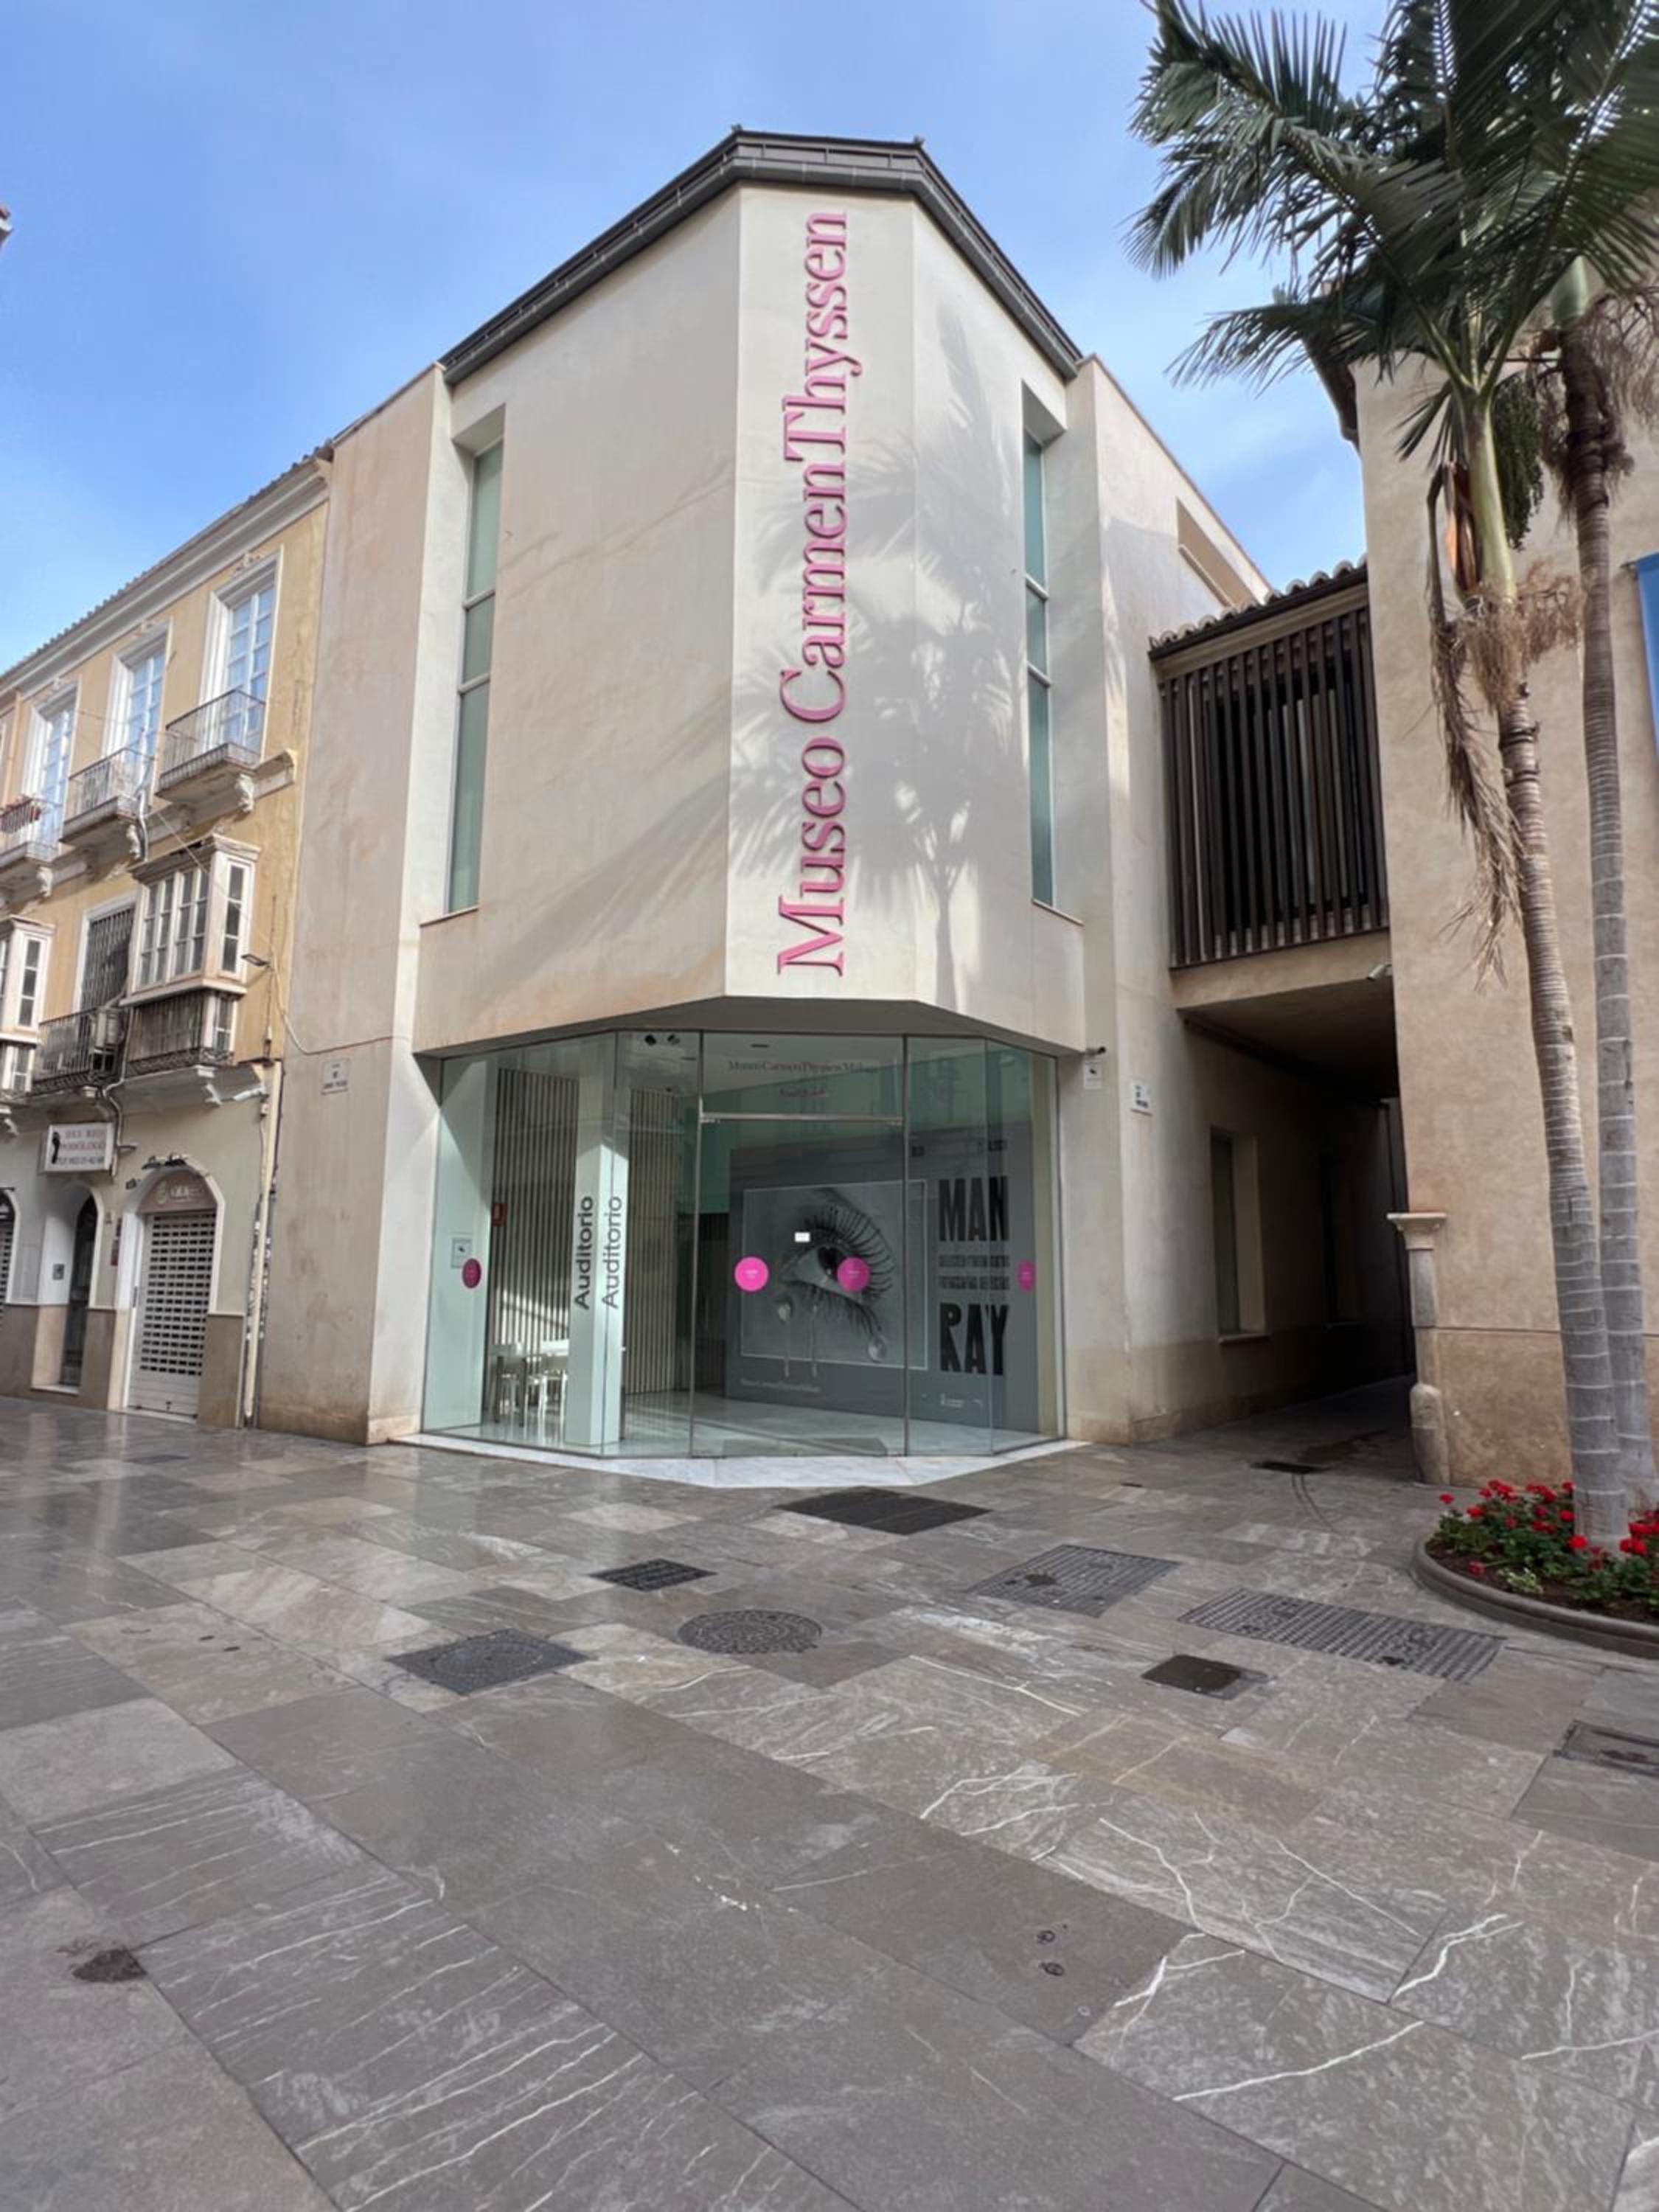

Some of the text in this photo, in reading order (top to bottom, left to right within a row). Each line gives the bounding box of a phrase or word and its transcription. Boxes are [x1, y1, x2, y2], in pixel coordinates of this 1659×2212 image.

[782, 212, 863, 462] Thyssen
[779, 460, 849, 724] Carmen
[777, 737, 846, 977] Museo
[574, 1196, 594, 1310] Auditorio
[602, 1196, 622, 1310] Auditorio
[939, 1175, 1009, 1242] MAN
[939, 1301, 1009, 1377] RAY
